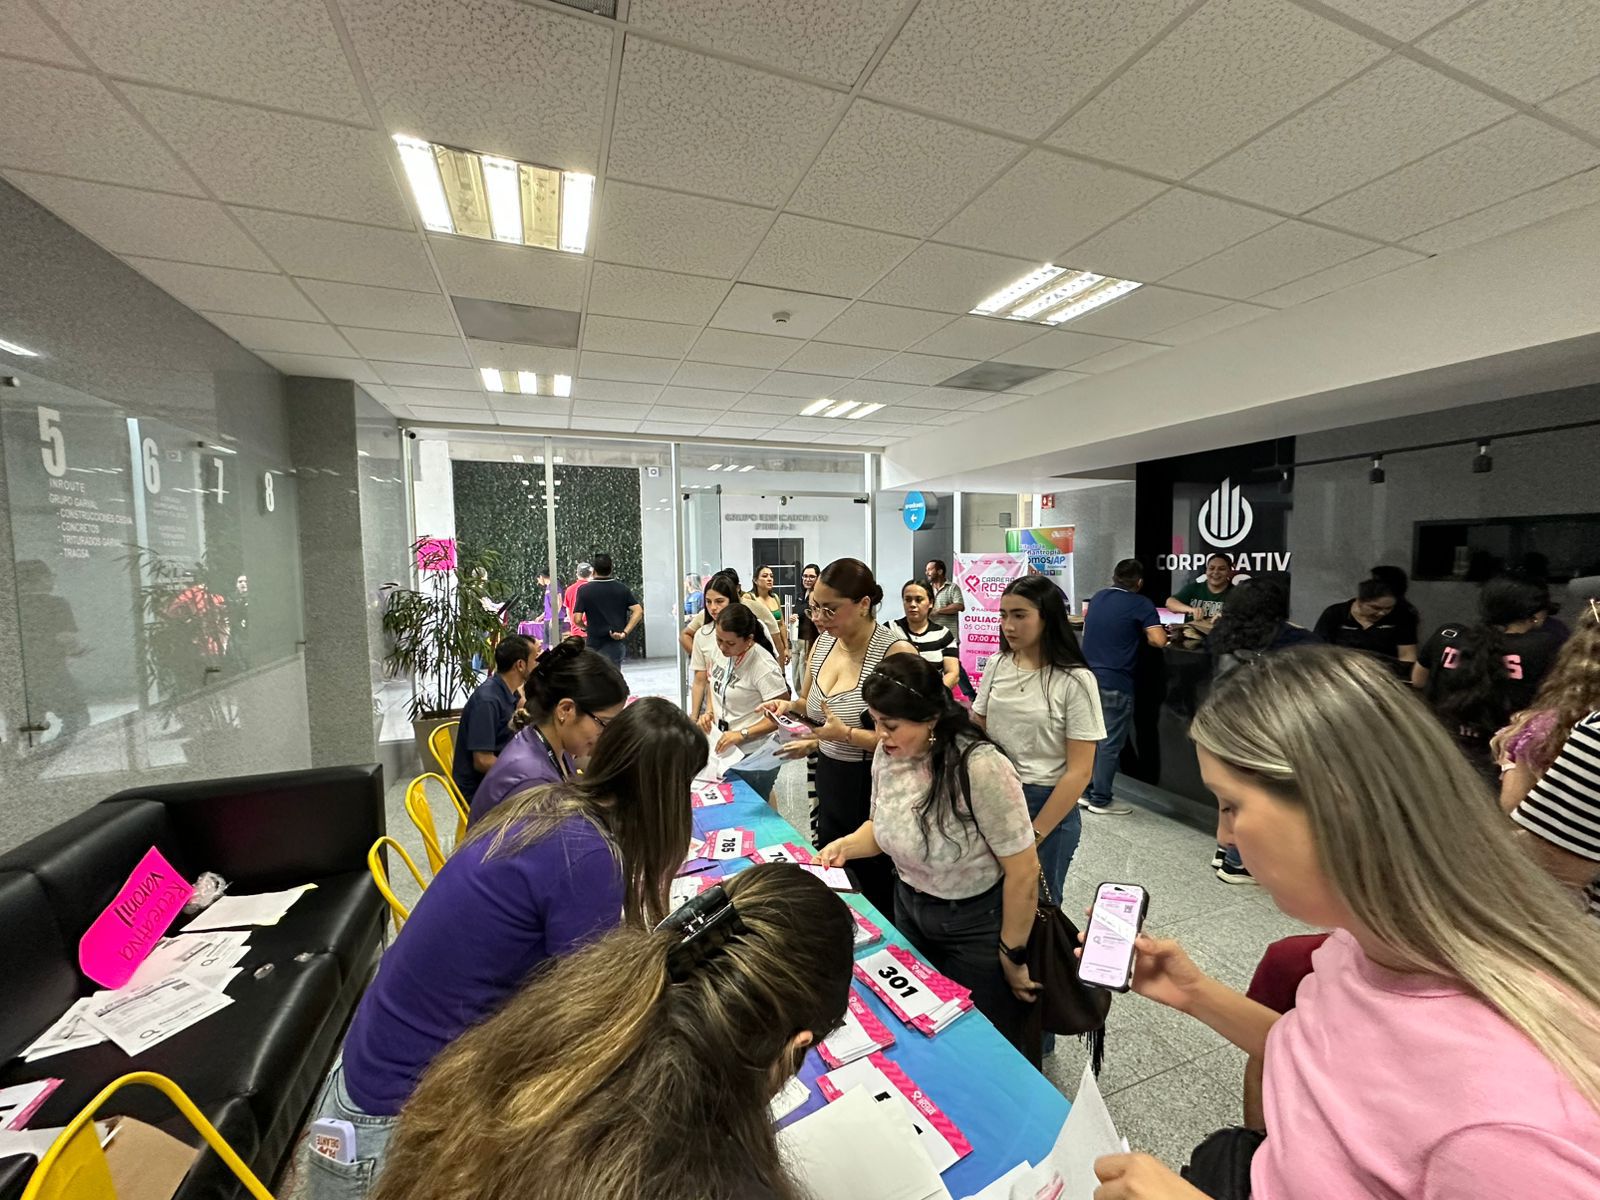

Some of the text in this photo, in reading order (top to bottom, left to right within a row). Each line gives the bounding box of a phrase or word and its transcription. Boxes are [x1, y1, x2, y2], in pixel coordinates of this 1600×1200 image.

[37, 406, 66, 477] 5
[143, 438, 160, 494] 6
[213, 457, 223, 504] 7
[264, 471, 275, 512] 8
[1156, 552, 1291, 571] CORPATIV
[981, 583, 1008, 593] ROS
[721, 837, 736, 853] 785
[119, 881, 190, 961] Recreativa
[878, 966, 919, 998] 301
